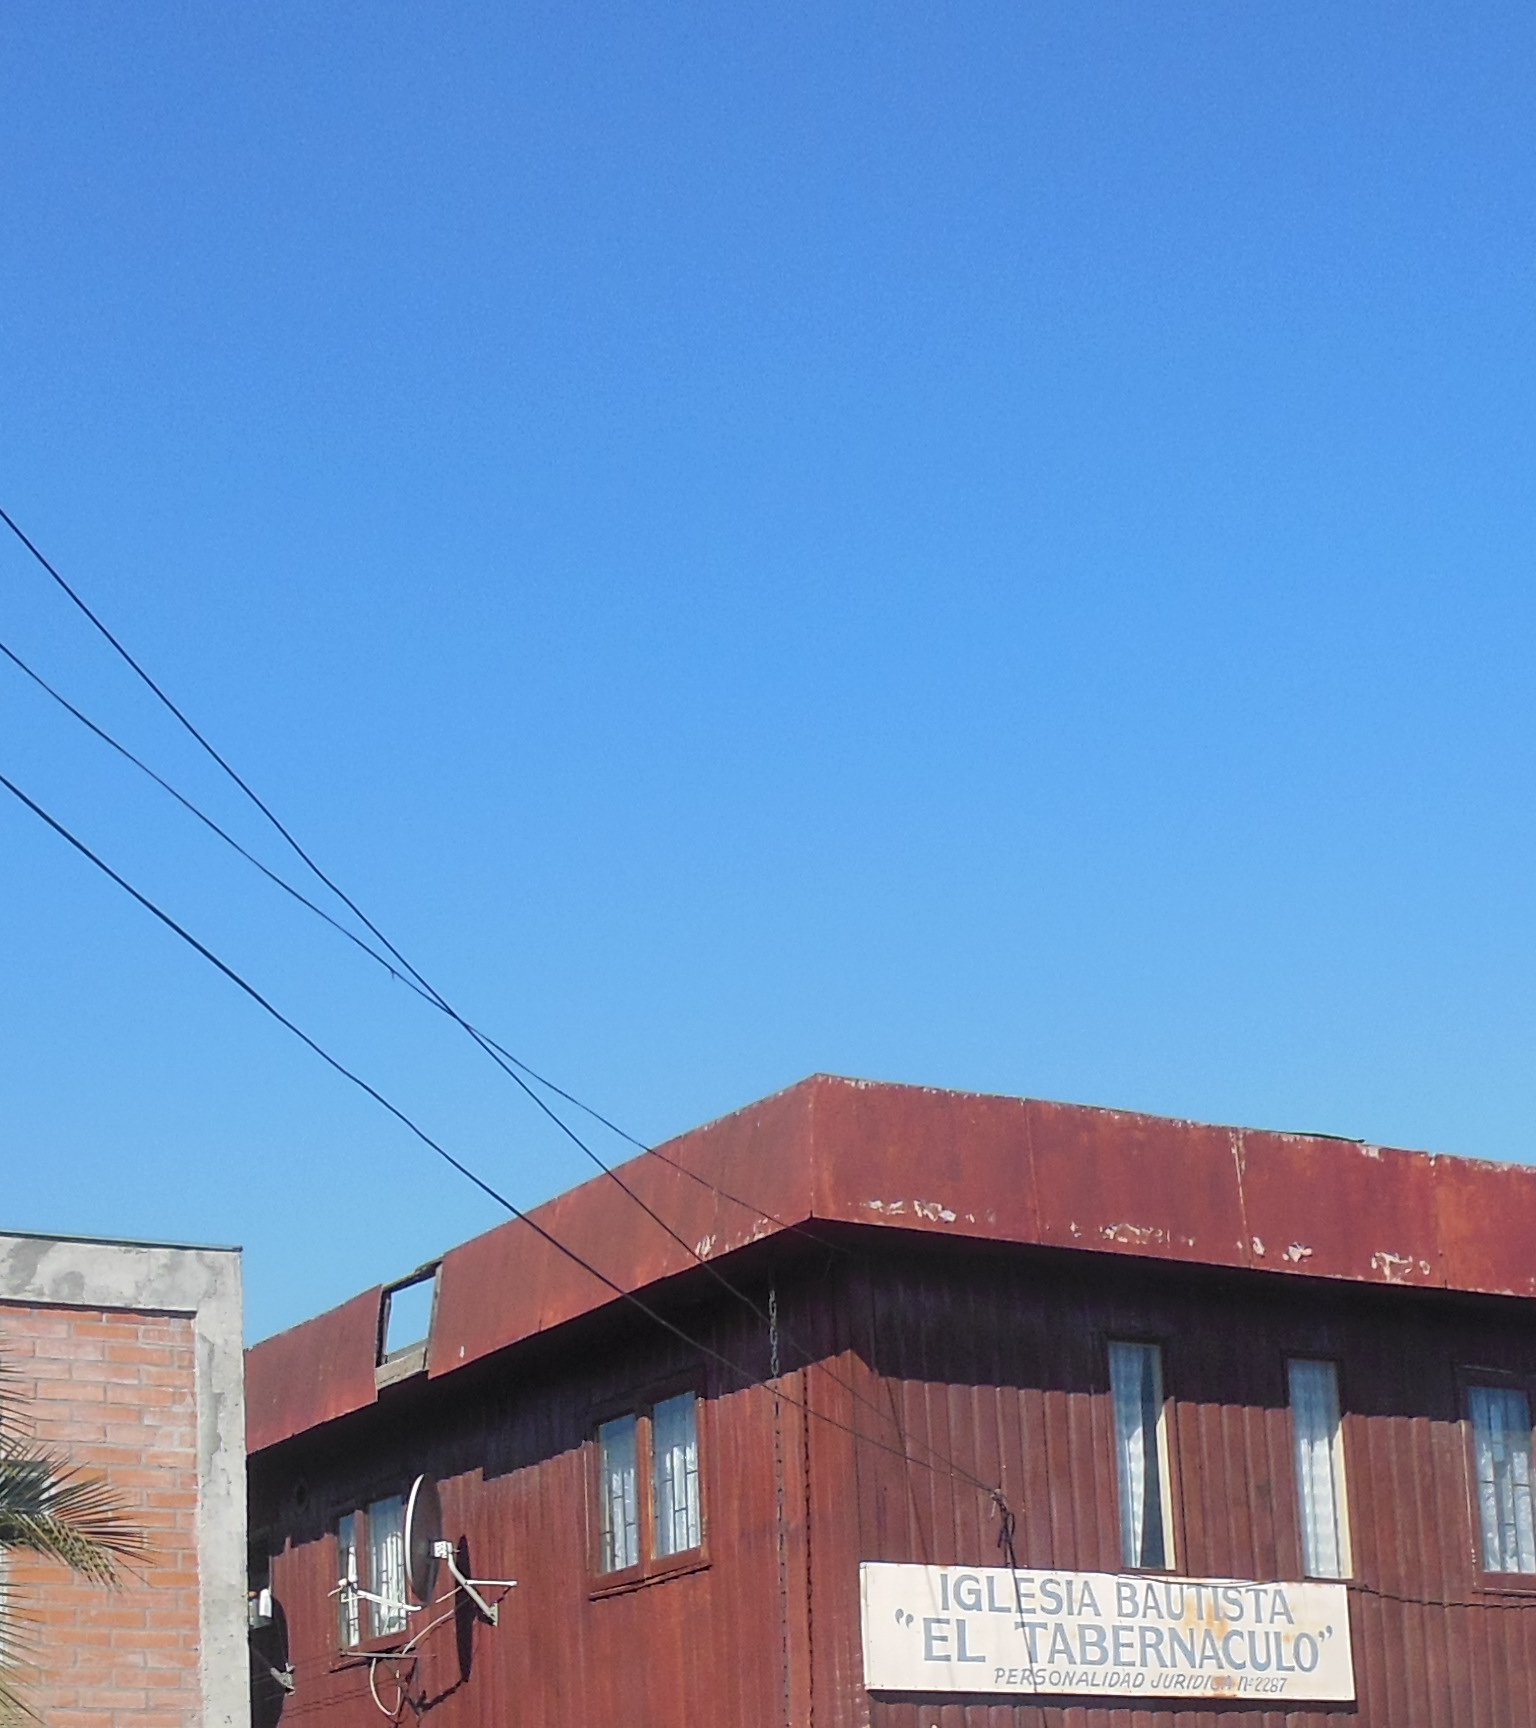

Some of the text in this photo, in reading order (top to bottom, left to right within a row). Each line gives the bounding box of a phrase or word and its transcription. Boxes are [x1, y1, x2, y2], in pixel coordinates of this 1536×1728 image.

[939, 1573, 1295, 1625] IGLESIA BAUTISTA
[994, 1667, 1145, 1689] PERSONALIDAD
[1151, 1672, 1232, 1691] JURIDICA
